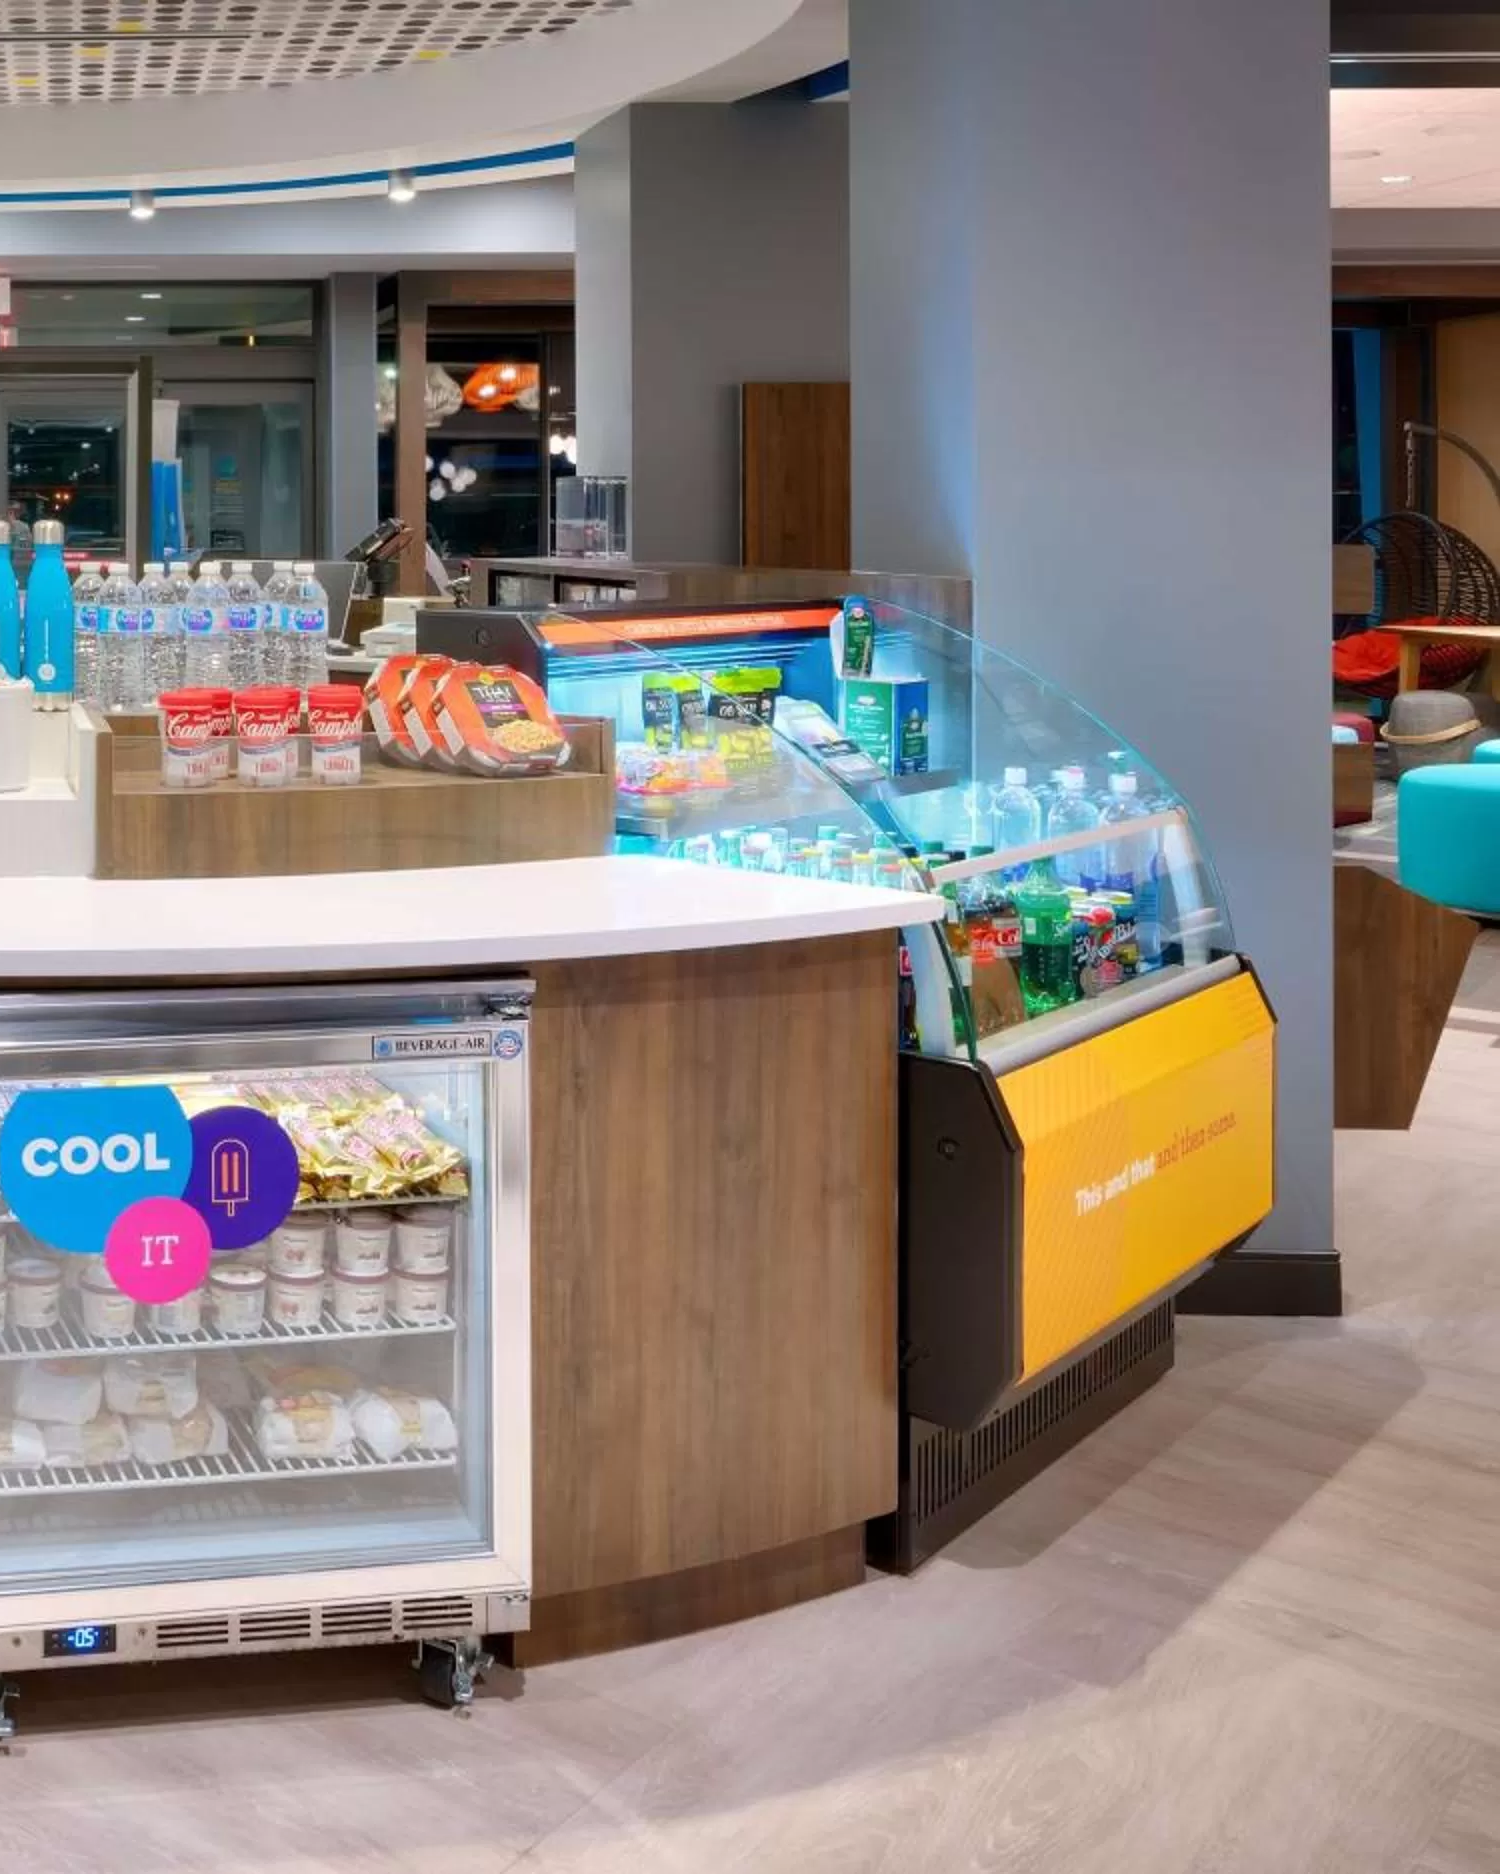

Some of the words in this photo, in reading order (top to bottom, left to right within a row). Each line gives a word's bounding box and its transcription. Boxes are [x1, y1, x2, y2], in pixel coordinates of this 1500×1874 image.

[395, 1037, 486, 1053] BEVERAGE-AIR
[21, 1132, 171, 1178] COOL
[1075, 1182, 1103, 1217] This
[1131, 1151, 1156, 1186] that
[141, 1234, 180, 1268] IT
